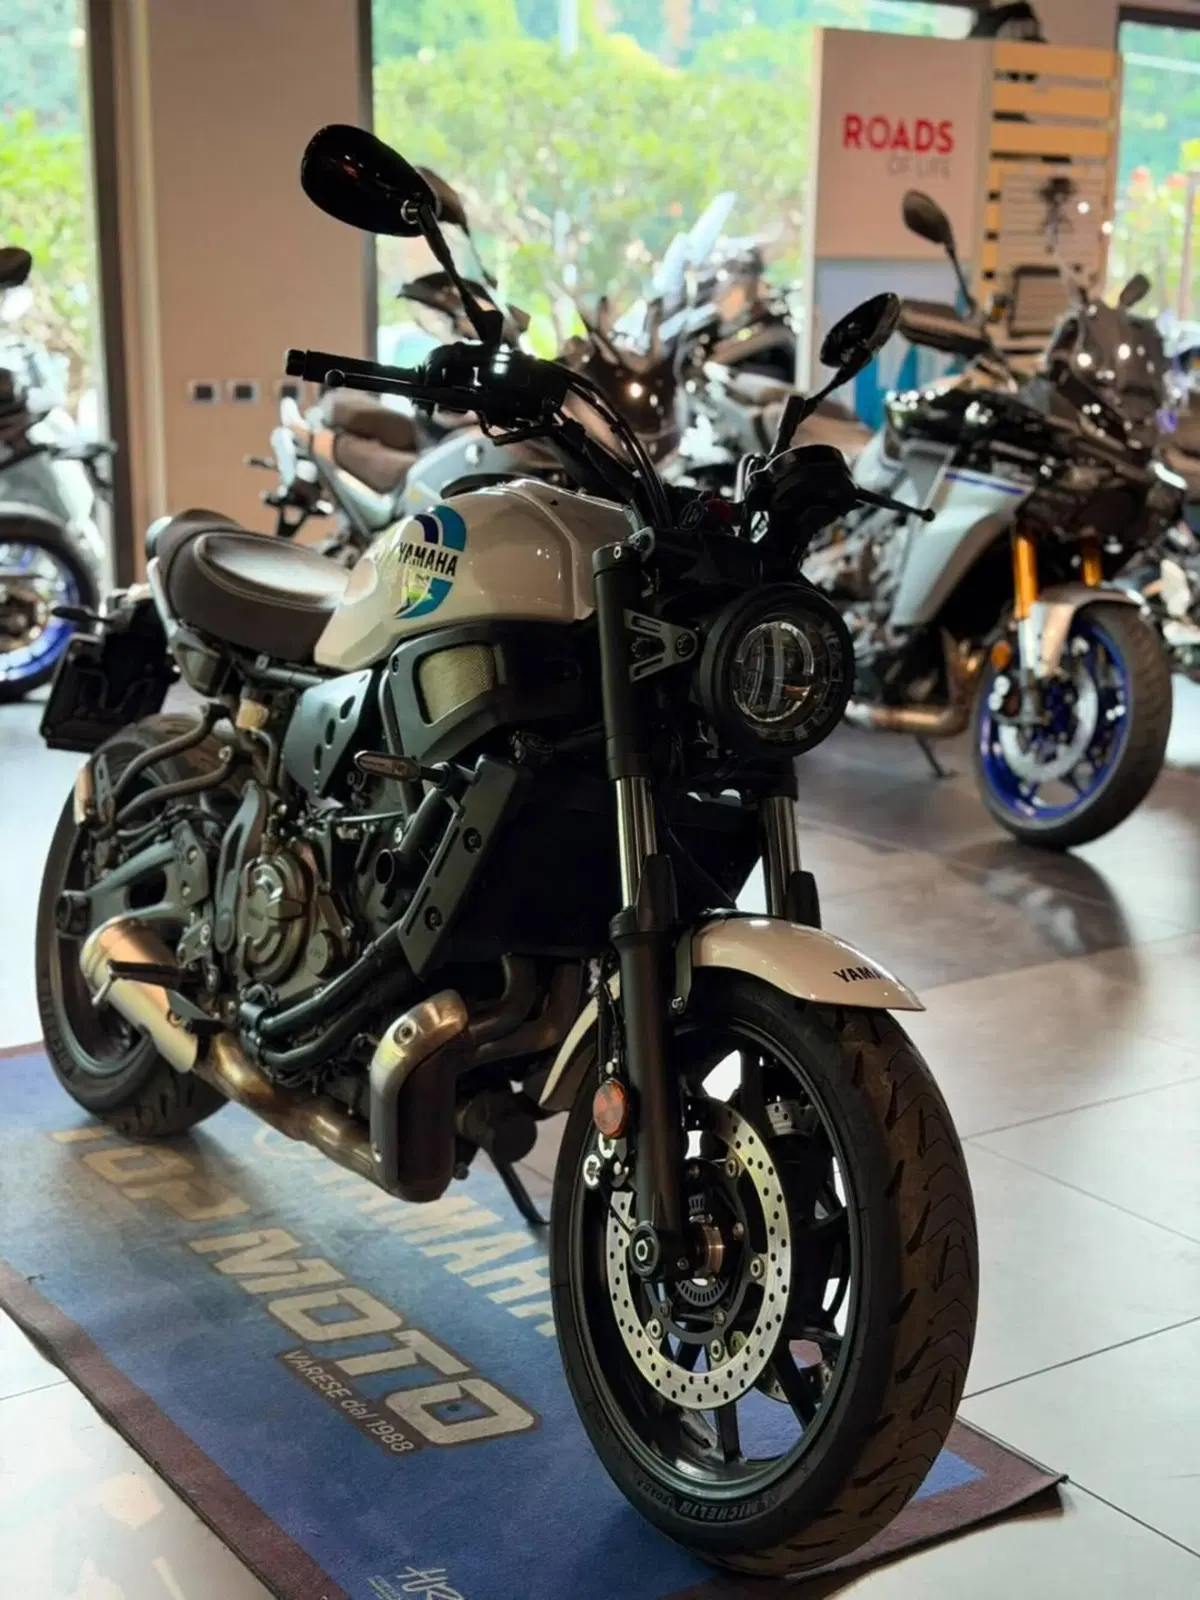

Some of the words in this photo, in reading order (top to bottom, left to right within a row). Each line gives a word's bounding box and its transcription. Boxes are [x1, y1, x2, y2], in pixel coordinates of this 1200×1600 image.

[842, 112, 955, 155] ROADS
[398, 541, 460, 577] YAMAHA
[188, 1228, 536, 1446] MOTO
[283, 1350, 353, 1399] VARESE
[340, 1399, 379, 1421] dal
[364, 1419, 415, 1453] 1988
[677, 1501, 759, 1522] MICHELIN
